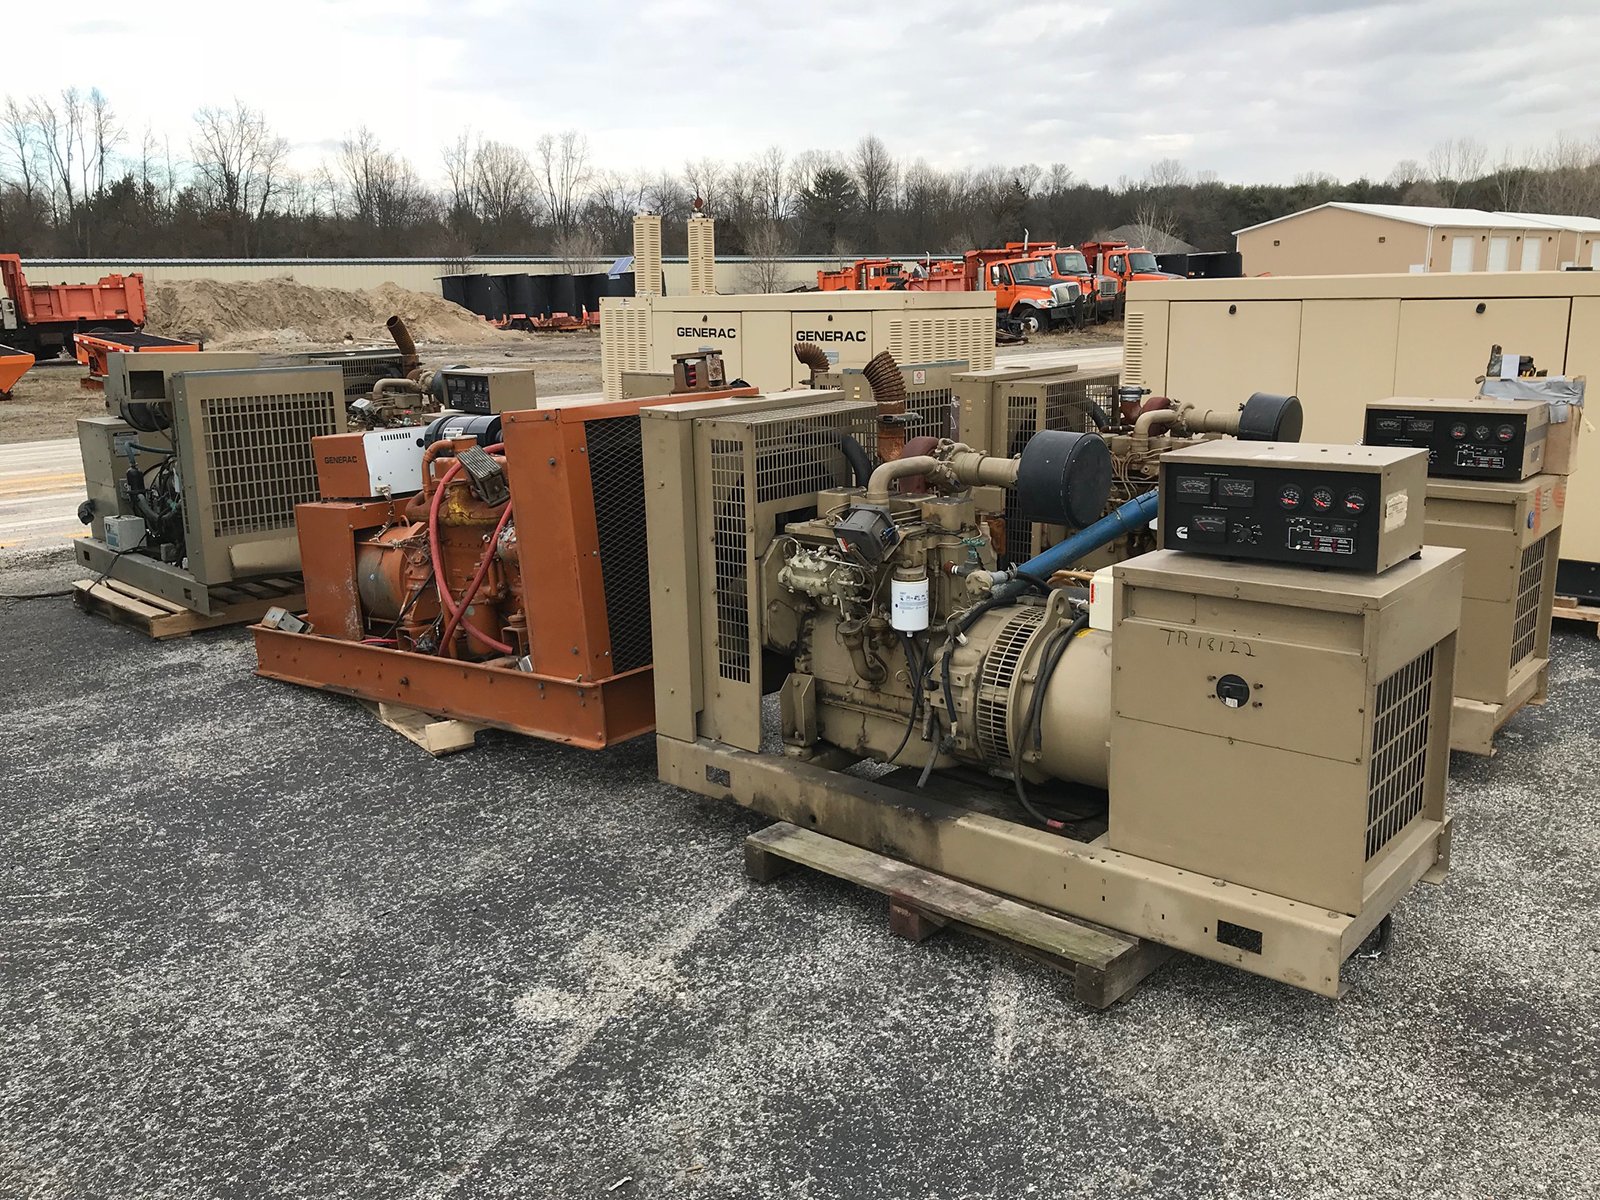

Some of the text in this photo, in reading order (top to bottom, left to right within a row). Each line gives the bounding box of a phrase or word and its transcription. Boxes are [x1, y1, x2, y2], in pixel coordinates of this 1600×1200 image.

[677, 327, 736, 338] GENERAC
[796, 331, 866, 342] GENERAC
[324, 456, 358, 464] GENERAC
